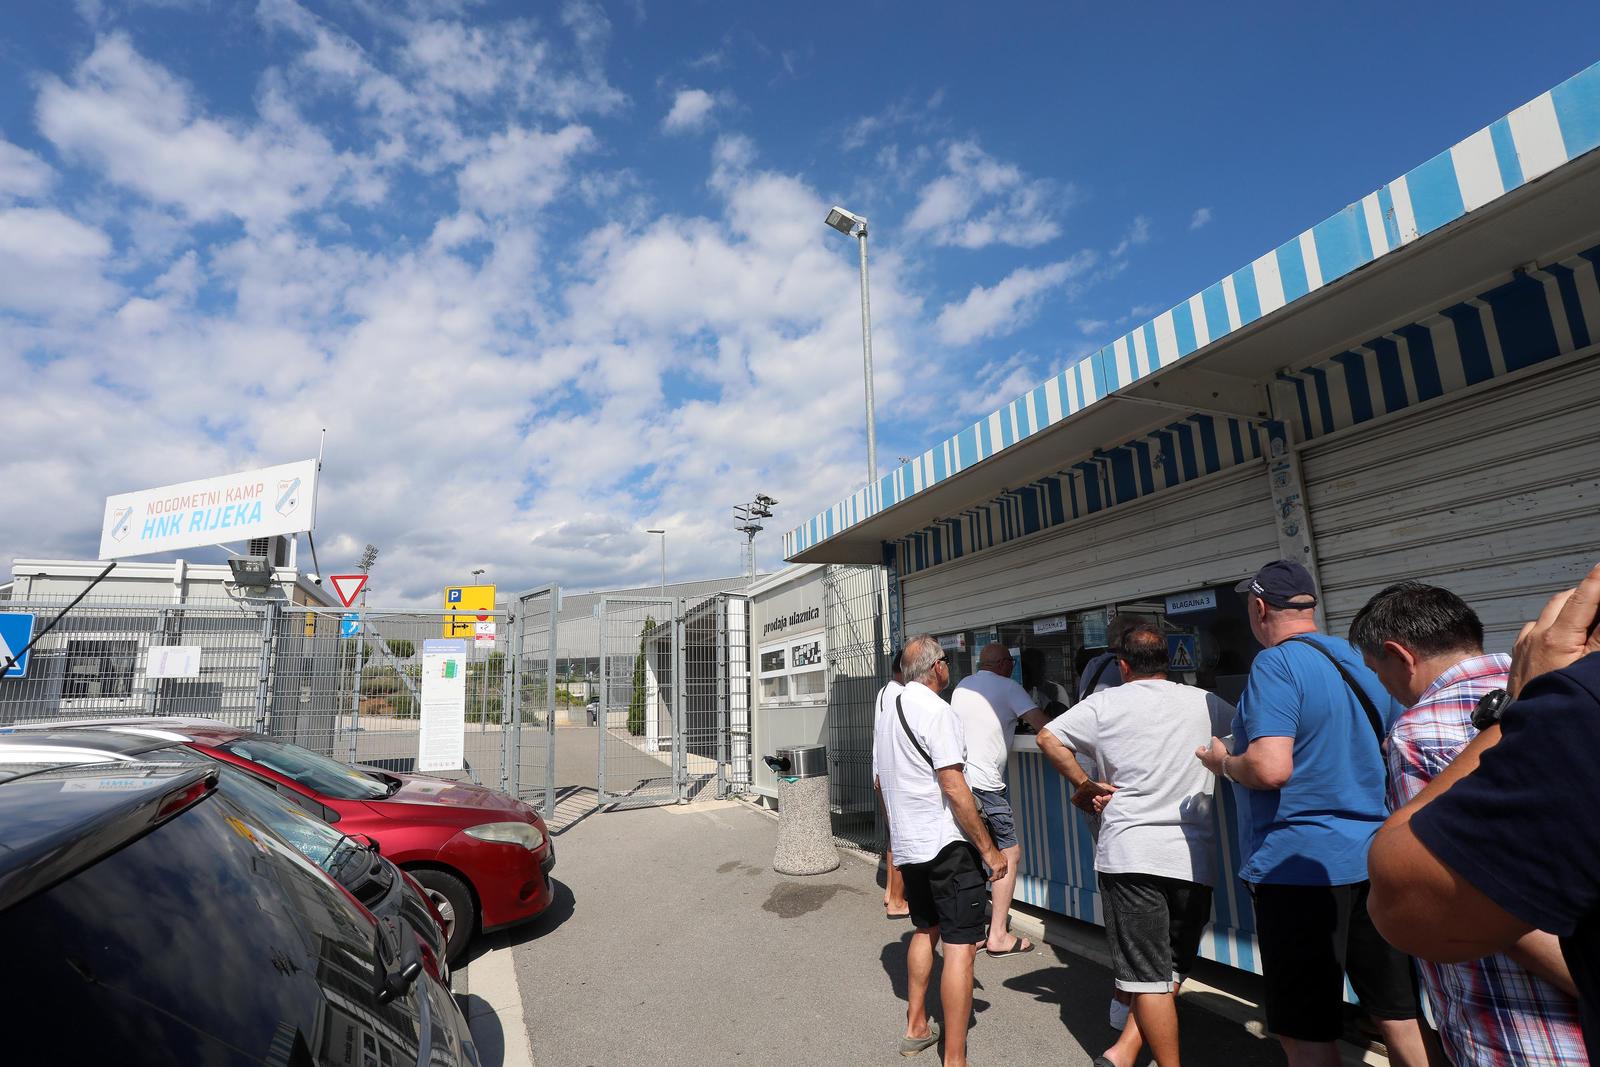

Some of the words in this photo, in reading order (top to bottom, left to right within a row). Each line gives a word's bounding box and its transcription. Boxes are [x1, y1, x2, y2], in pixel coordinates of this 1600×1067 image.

[147, 491, 221, 515] NOGOMETNI
[226, 483, 264, 502] KAMP
[141, 513, 184, 540] HNK
[188, 501, 262, 533] RIJEKA
[451, 591, 459, 601] P
[763, 615, 787, 637] prodaja
[789, 606, 819, 626] ulaznica
